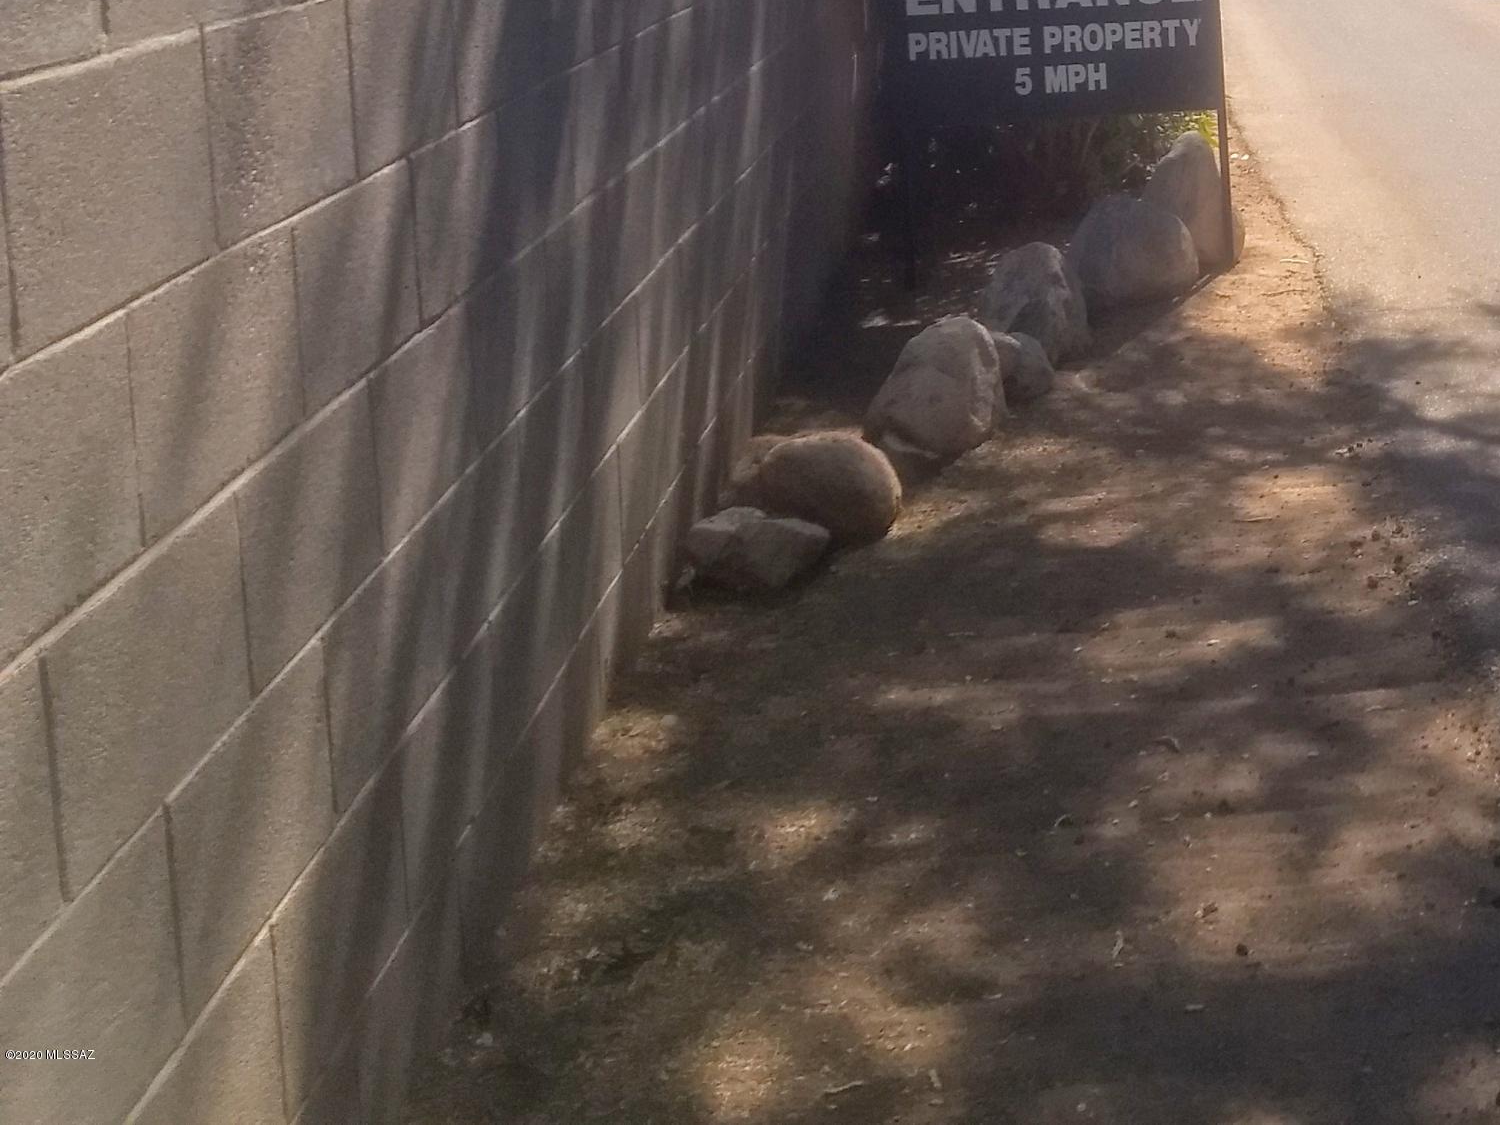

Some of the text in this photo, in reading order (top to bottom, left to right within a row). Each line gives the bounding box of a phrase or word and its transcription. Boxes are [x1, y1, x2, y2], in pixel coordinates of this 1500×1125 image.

[908, 18, 1201, 61] PRIVATE PROPERTY
[1015, 63, 1107, 95] 5 MPH
